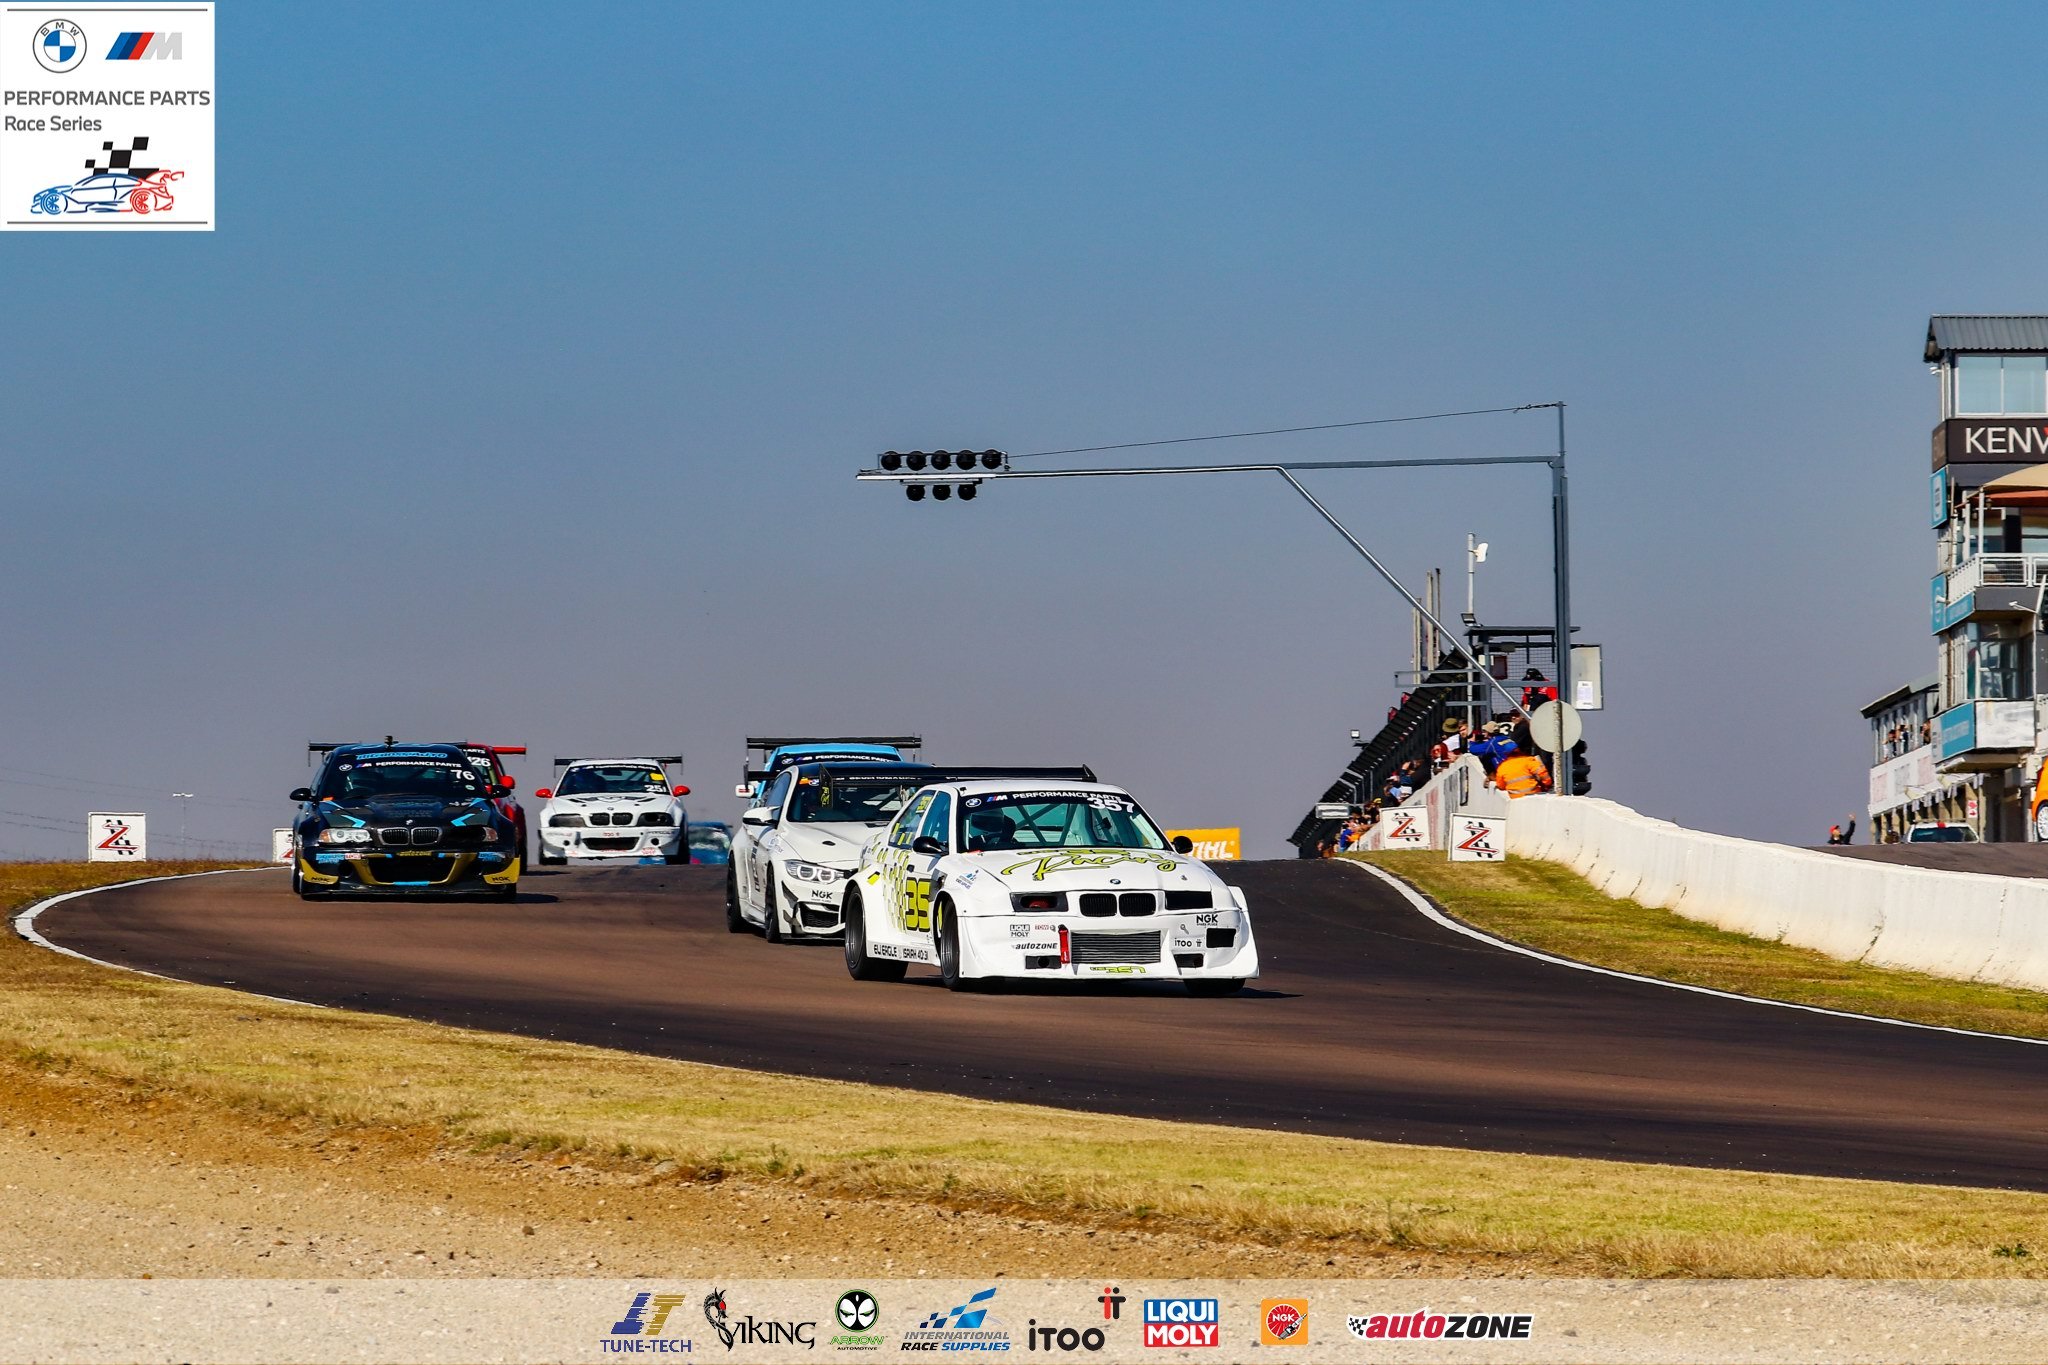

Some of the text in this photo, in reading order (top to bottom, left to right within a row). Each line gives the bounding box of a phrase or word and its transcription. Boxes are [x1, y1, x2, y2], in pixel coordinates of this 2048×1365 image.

[451, 769, 475, 780] 76
[1013, 791, 1088, 799] PERFORMANCE
[1087, 797, 1135, 813] 357
[1188, 841, 1234, 859] TIHL
[1001, 853, 1187, 881] Racing
[811, 889, 833, 899] NGK
[1196, 914, 1218, 923] NGK
